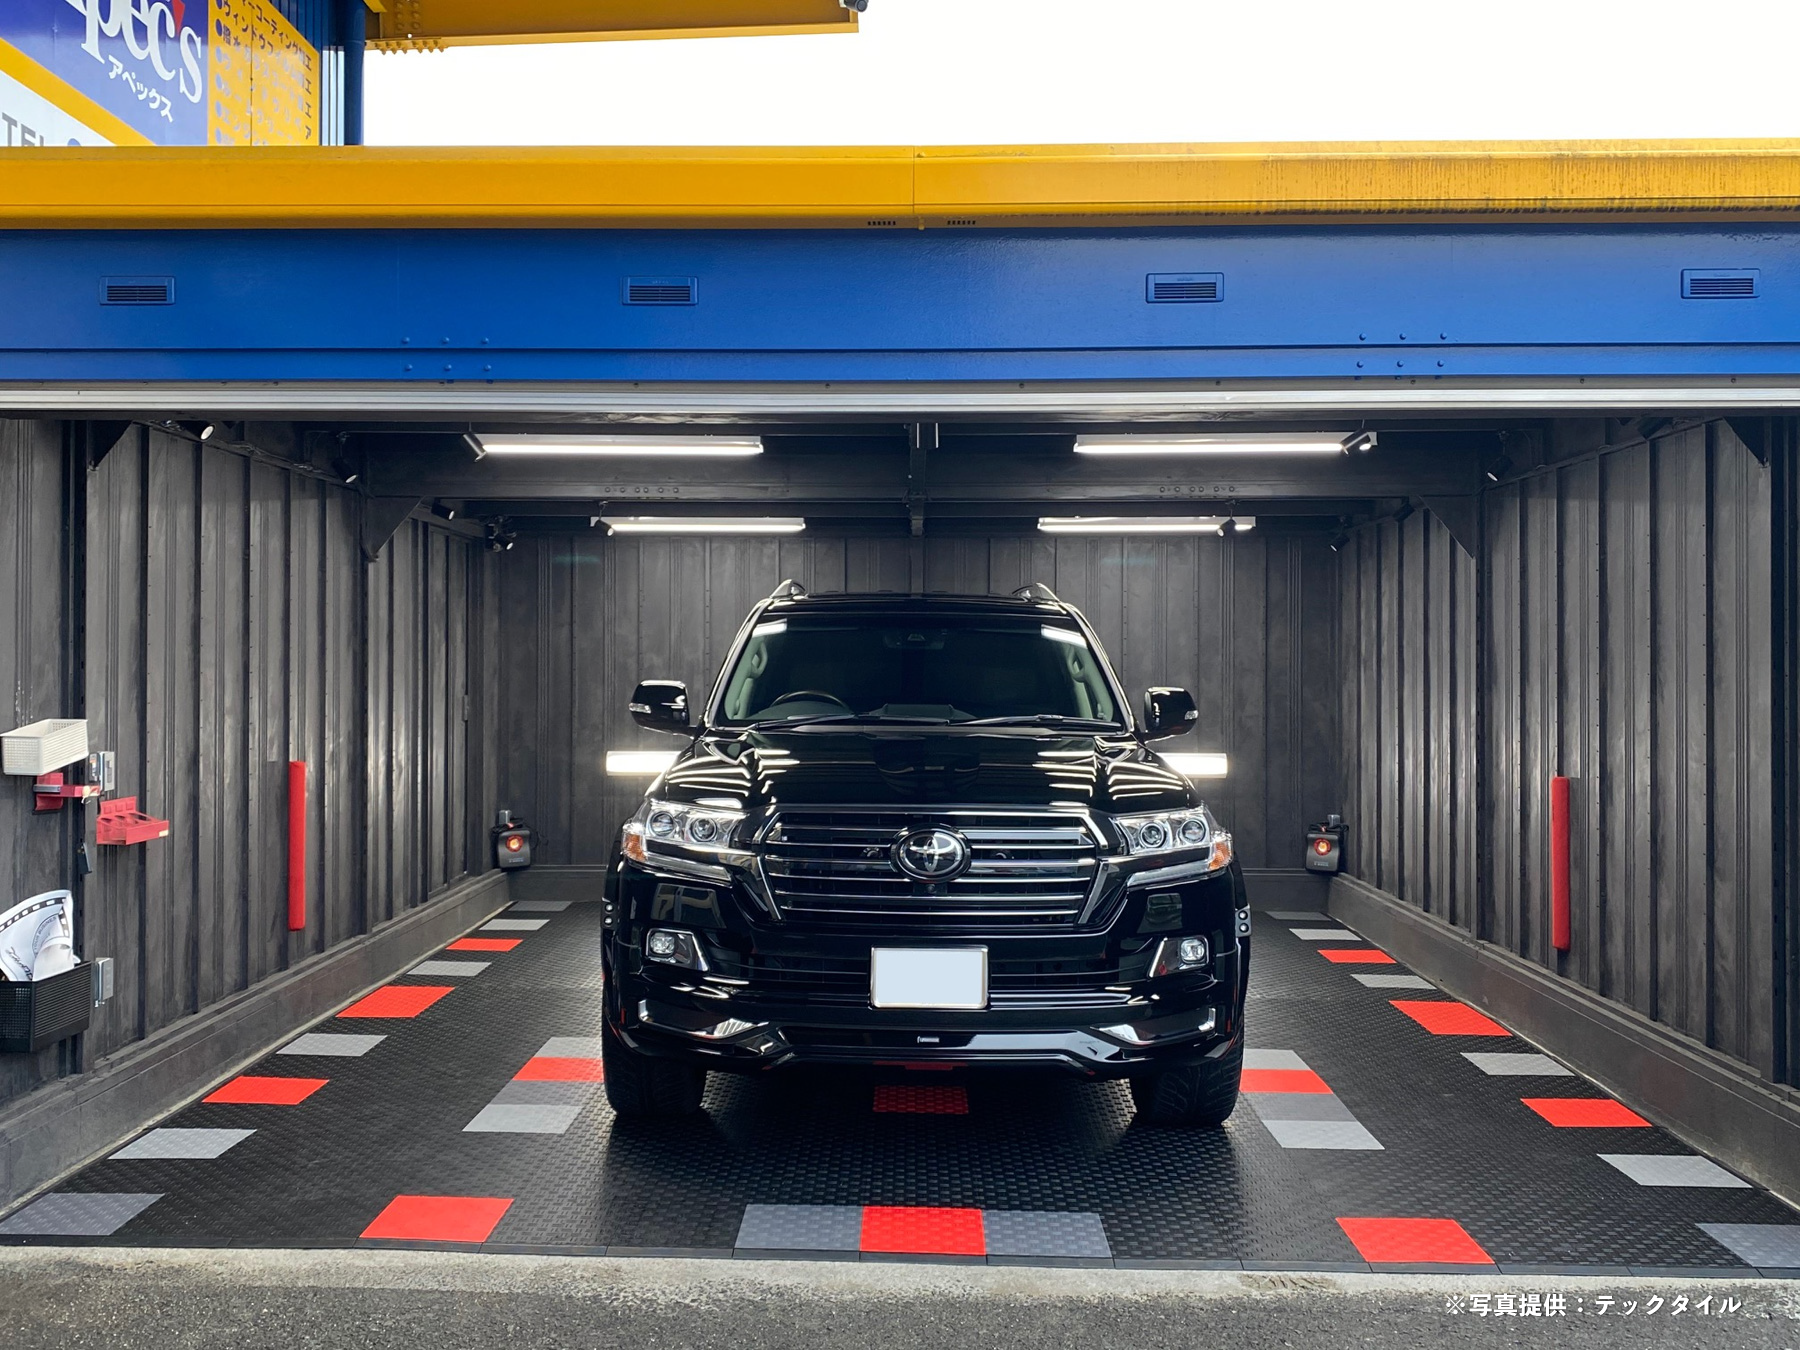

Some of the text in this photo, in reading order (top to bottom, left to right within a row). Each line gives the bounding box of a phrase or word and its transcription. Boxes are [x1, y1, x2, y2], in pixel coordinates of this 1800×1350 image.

[108, 54, 174, 123] アペックス
